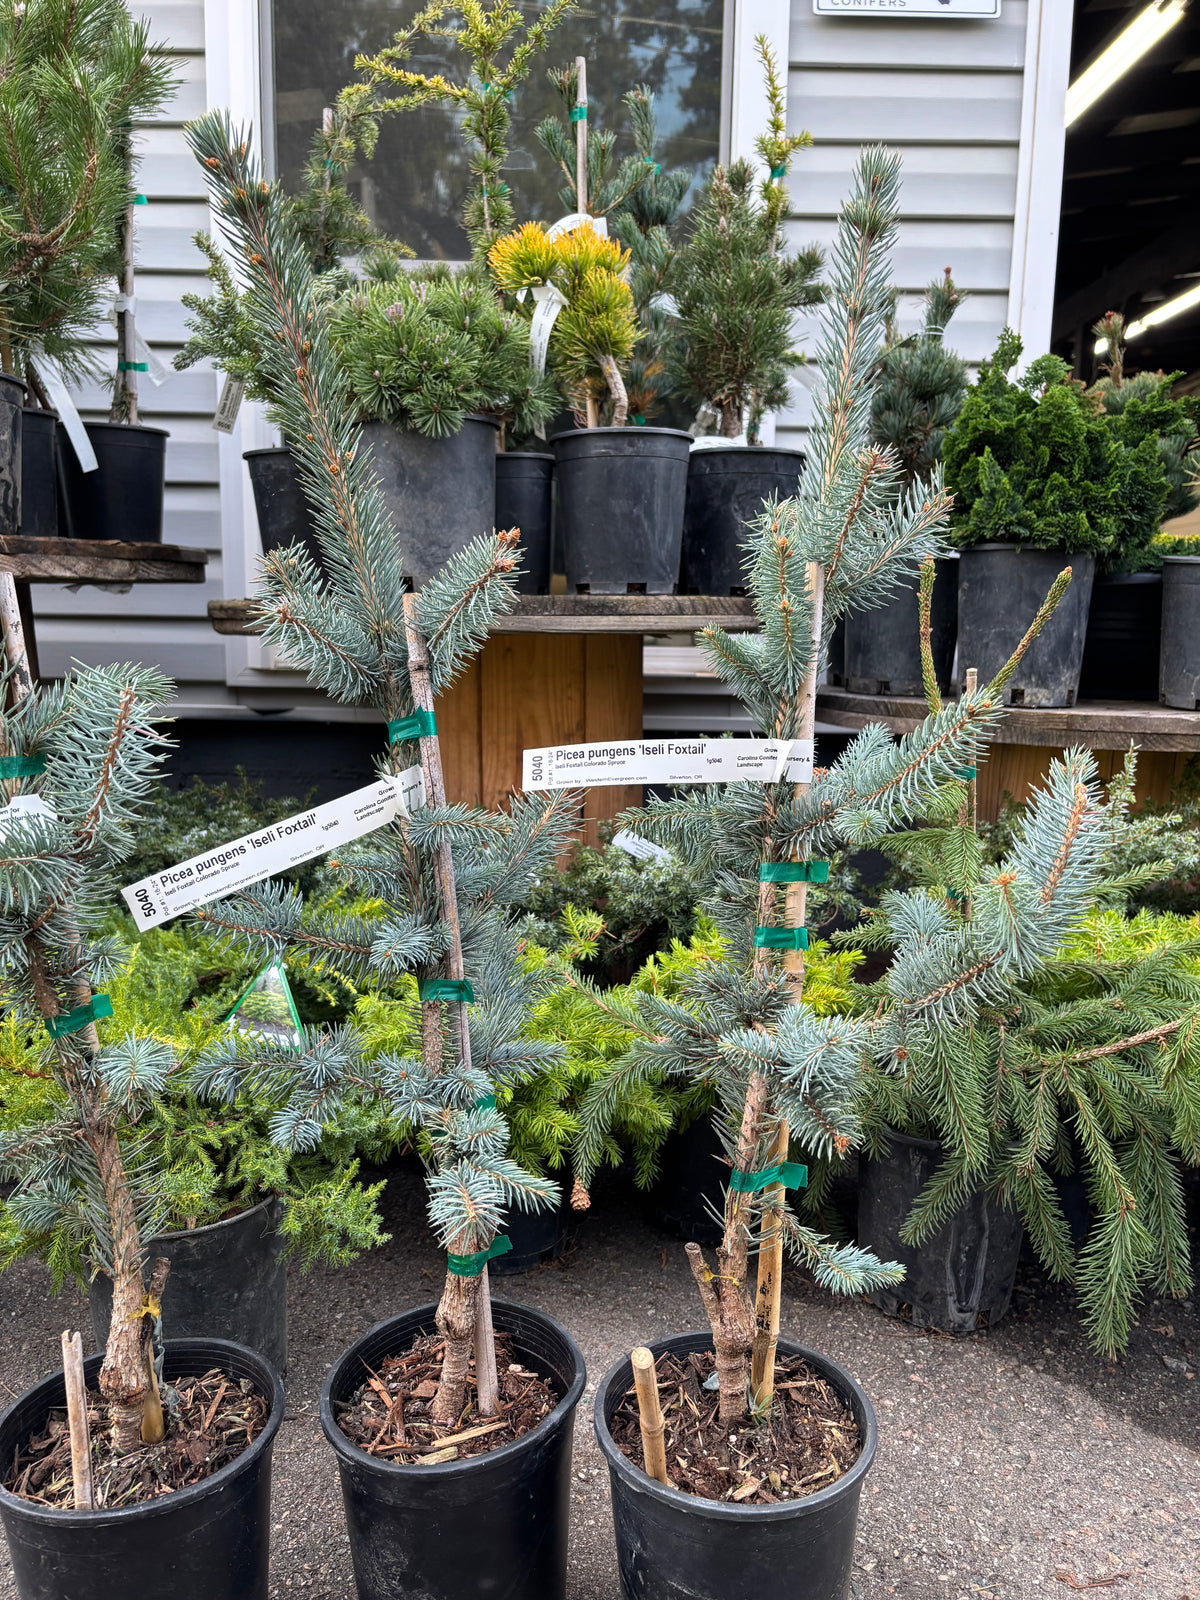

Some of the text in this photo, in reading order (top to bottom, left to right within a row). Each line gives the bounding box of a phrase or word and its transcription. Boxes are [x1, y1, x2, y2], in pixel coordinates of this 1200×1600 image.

[556, 743, 706, 761] Picea pungens 'Iseli Foxtail'
[532, 755, 543, 781] 5040
[566, 761, 583, 769] Foxtail
[353, 802, 377, 815] Carolina
[356, 806, 385, 821] Landscape
[159, 812, 317, 888] Picea pungens 'Iseli Foxtail'
[164, 861, 240, 896] Iseli Foxtail Colorado Spruce
[134, 888, 157, 918] 5040
